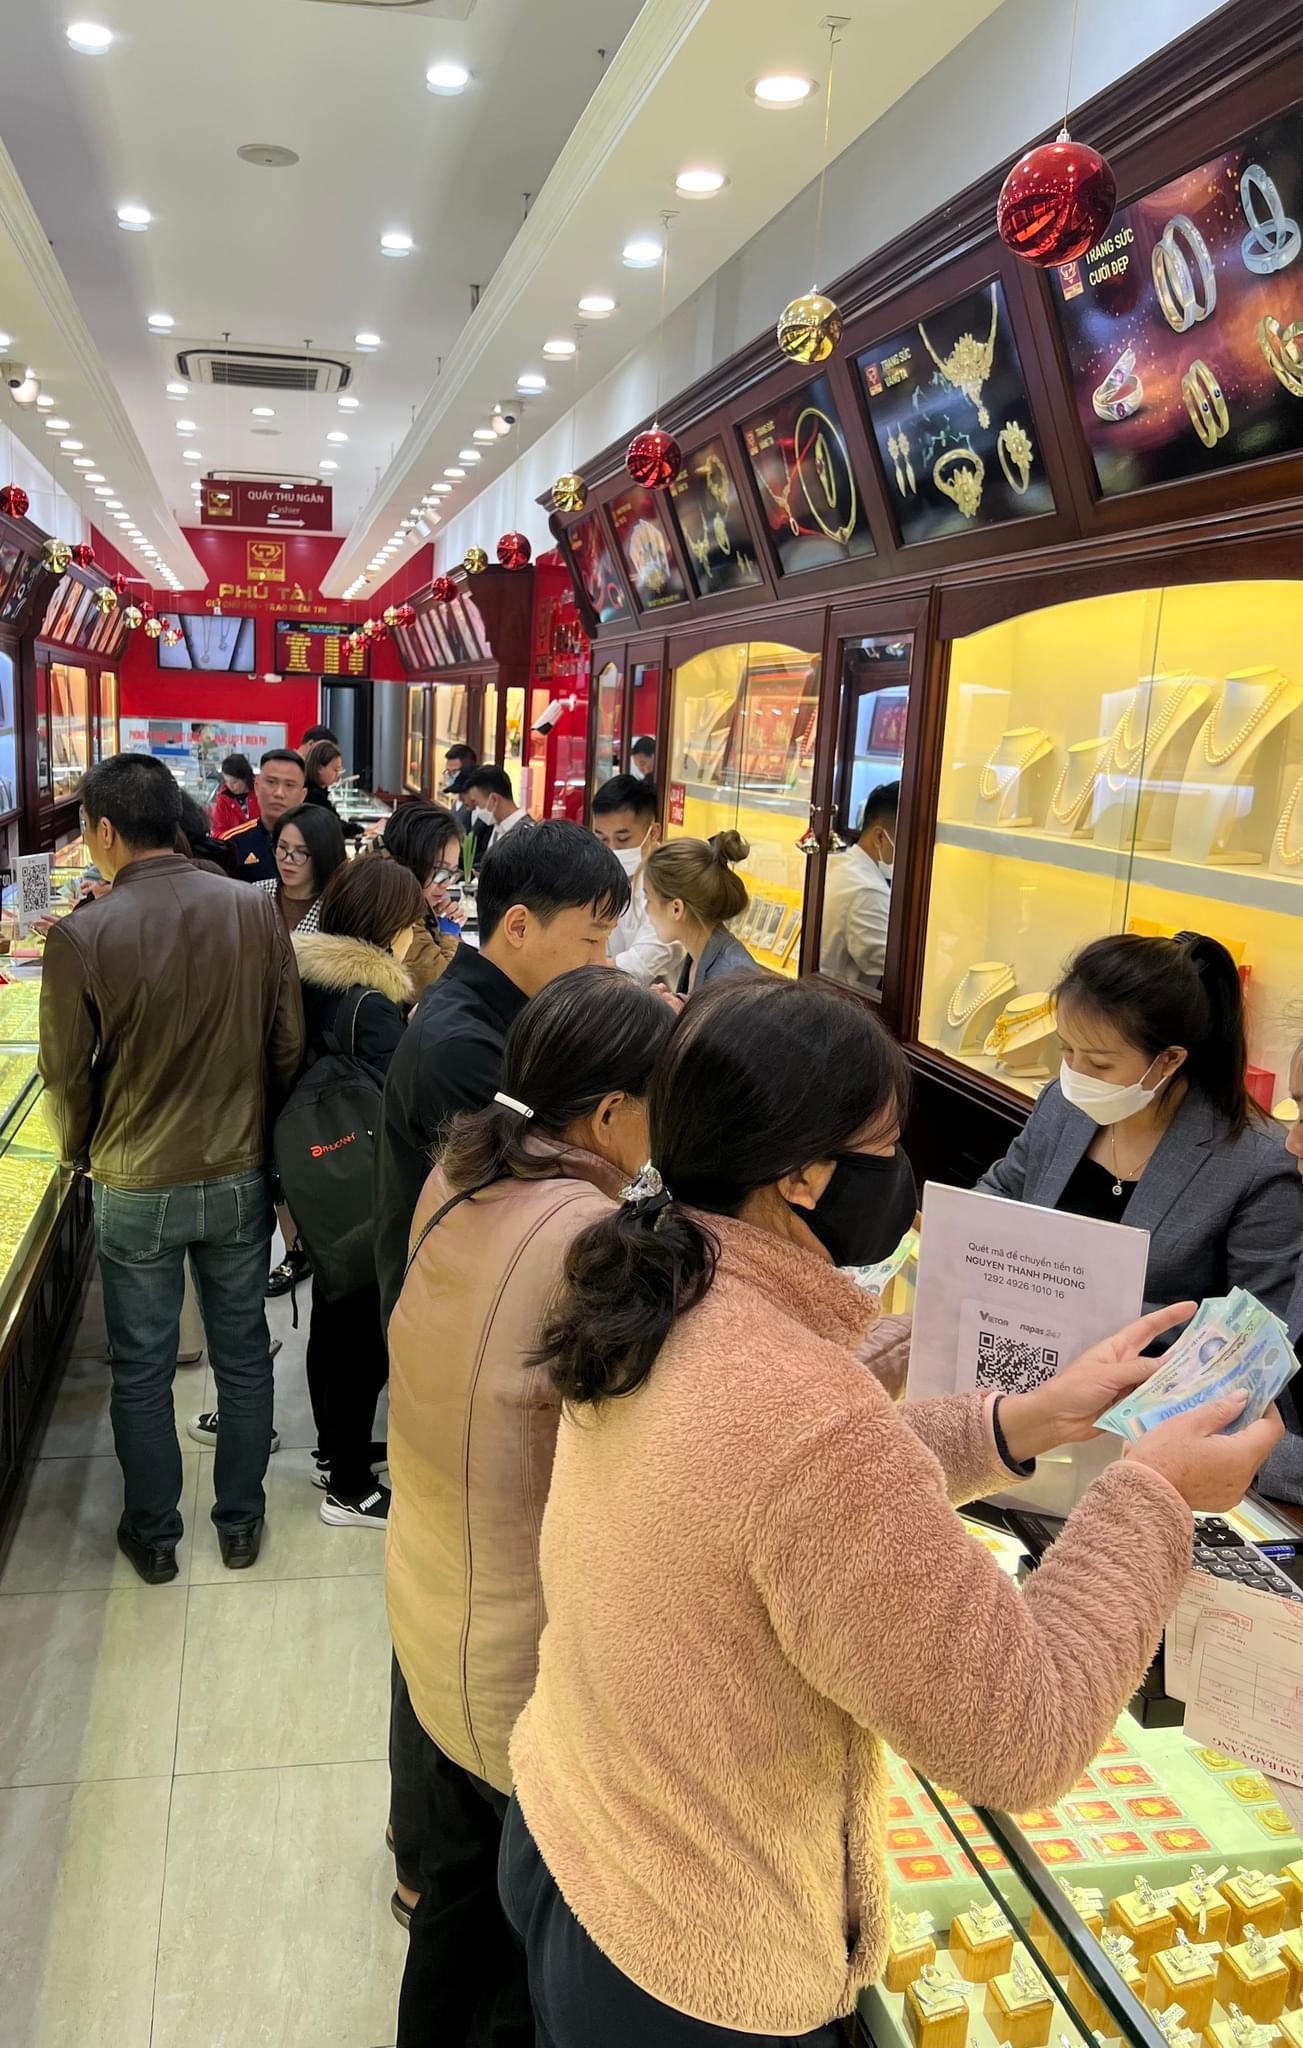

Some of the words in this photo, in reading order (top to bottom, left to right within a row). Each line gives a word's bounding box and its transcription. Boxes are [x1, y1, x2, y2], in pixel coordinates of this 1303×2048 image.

[1114, 227, 1134, 249] SỨC
[1110, 255, 1129, 275] ĐẸP
[276, 492, 295, 502] THU
[296, 492, 324, 504] NGÂN
[271, 504, 300, 515] Cashier
[219, 582, 269, 600] PHÚ
[278, 582, 313, 602] TÀI
[968, 1242, 989, 1254] Quét
[991, 1247, 1004, 1257] mã
[1006, 1250, 1018, 1260] để
[1019, 1253, 1051, 1267] chuyển
[1054, 1261, 1070, 1272] tiền
[965, 1255, 1005, 1271] NGUYEN
[1007, 1264, 1041, 1279] THANH
[1043, 1272, 1086, 1290] PHUONG
[983, 1272, 1005, 1285] 1292
[1006, 1278, 1030, 1291] 4926
[1032, 1284, 1052, 1296] 1010
[1055, 1289, 1065, 1299] 16
[1019, 1322, 1045, 1336] napas
[359, 1491, 382, 1512] PUMA
